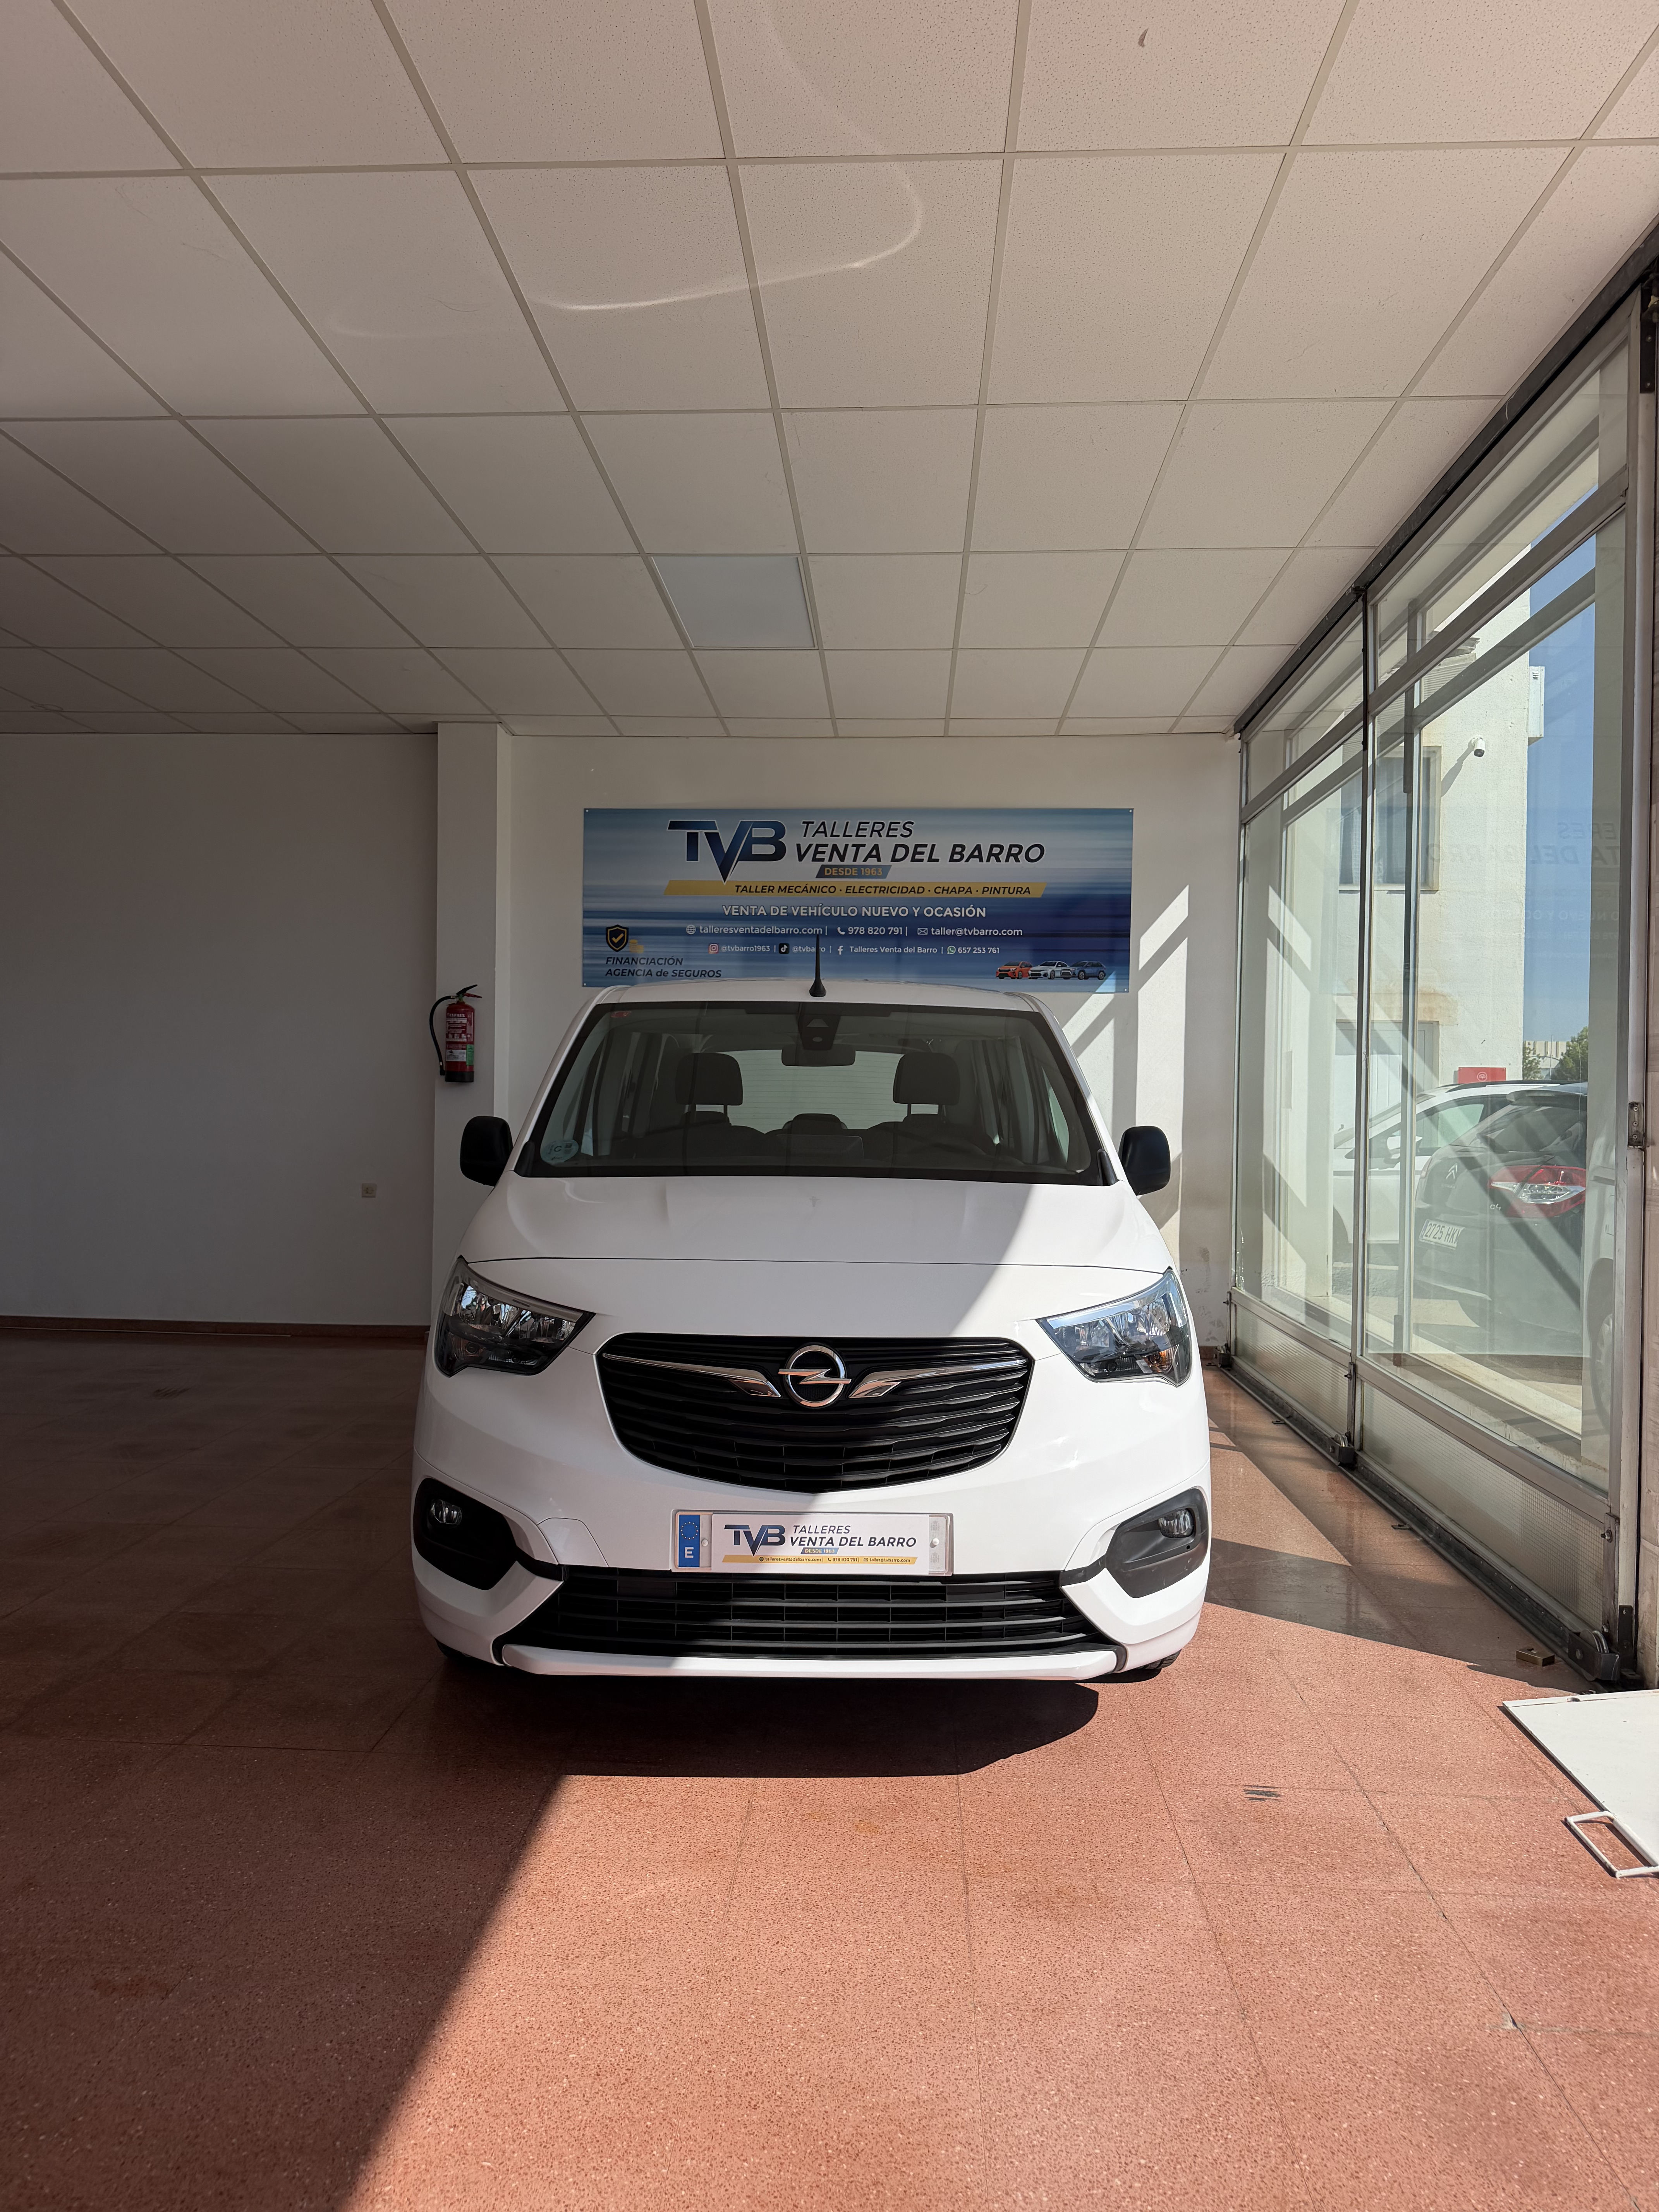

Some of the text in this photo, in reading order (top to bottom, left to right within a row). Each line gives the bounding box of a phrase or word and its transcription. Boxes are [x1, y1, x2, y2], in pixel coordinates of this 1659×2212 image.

[802, 821, 915, 838] TALLERES
[667, 820, 786, 883] TVB
[796, 843, 1045, 863] VENTA DEL BARRO
[824, 867, 883, 876] DESDE 1963
[735, 883, 1031, 895] TALLER MECÁNICO ELECTRICIDAD CHAPA PINTURA
[723, 903, 986, 917] VENTA DE VEHÍCULO NUEVO Y OCASIÓN
[699, 925, 823, 934] talleresventadelbarro.com
[848, 927, 865, 935] 978
[867, 927, 886, 935] 820
[931, 927, 1023, 936] taller@tvbarro.com
[606, 956, 684, 965] FINANCIACIÓN
[605, 969, 722, 978] AGENCIA de SEGUROS
[1424, 1223, 1445, 1240] 2725
[793, 1525, 851, 1534] TALLERES
[724, 1524, 786, 1556] TVB
[790, 1536, 917, 1547] VENTA DEL BARRO
[685, 1547, 694, 1558] E
